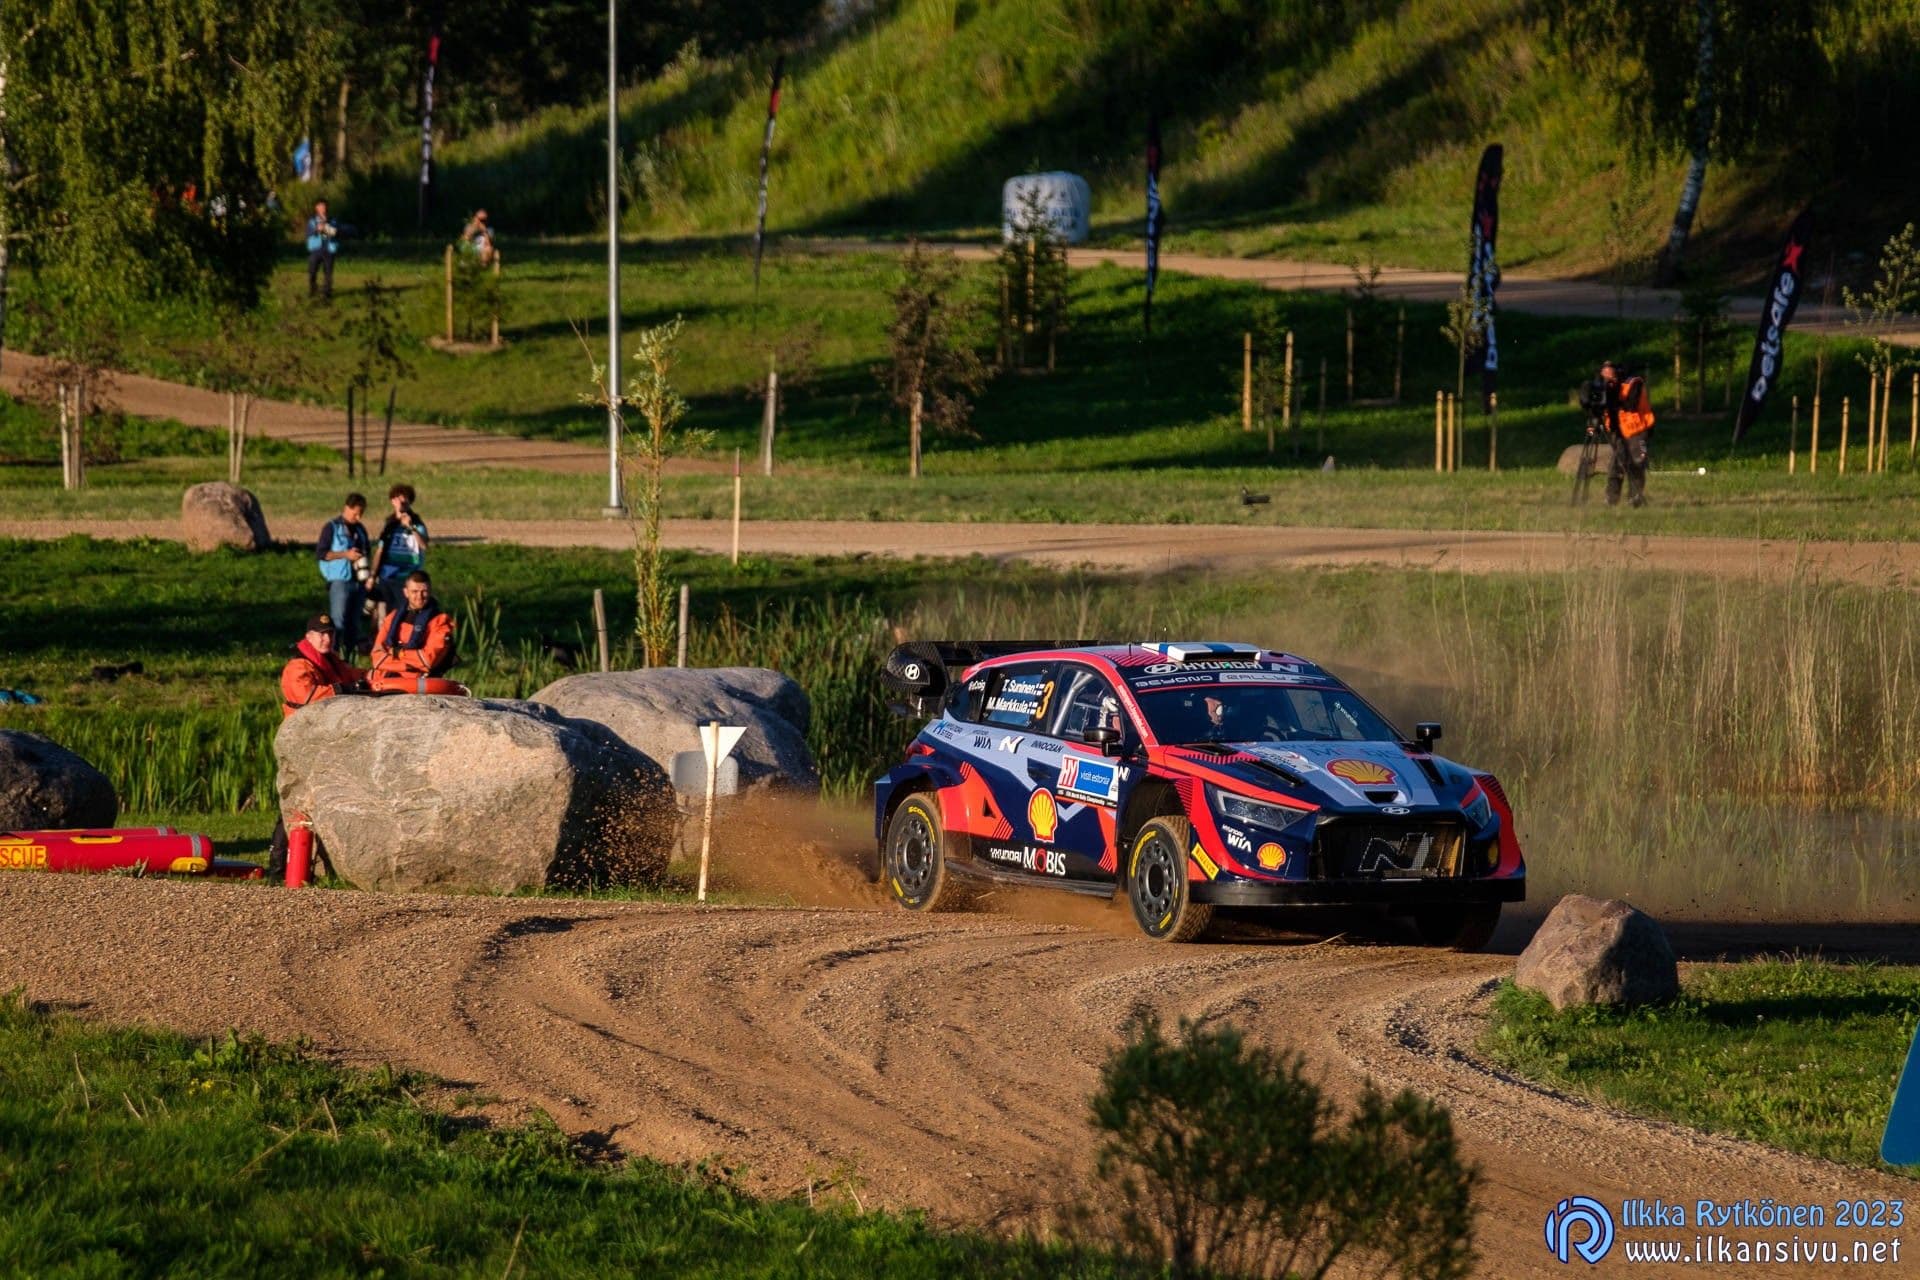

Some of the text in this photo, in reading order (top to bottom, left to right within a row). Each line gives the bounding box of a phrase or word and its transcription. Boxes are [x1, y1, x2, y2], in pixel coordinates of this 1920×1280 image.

[1135, 675, 1213, 687] BEYOND
[1036, 681, 1054, 719] 3
[974, 735, 991, 749] WIA
[1227, 833, 1252, 853] WIA
[1023, 846, 1066, 876] MOBIS
